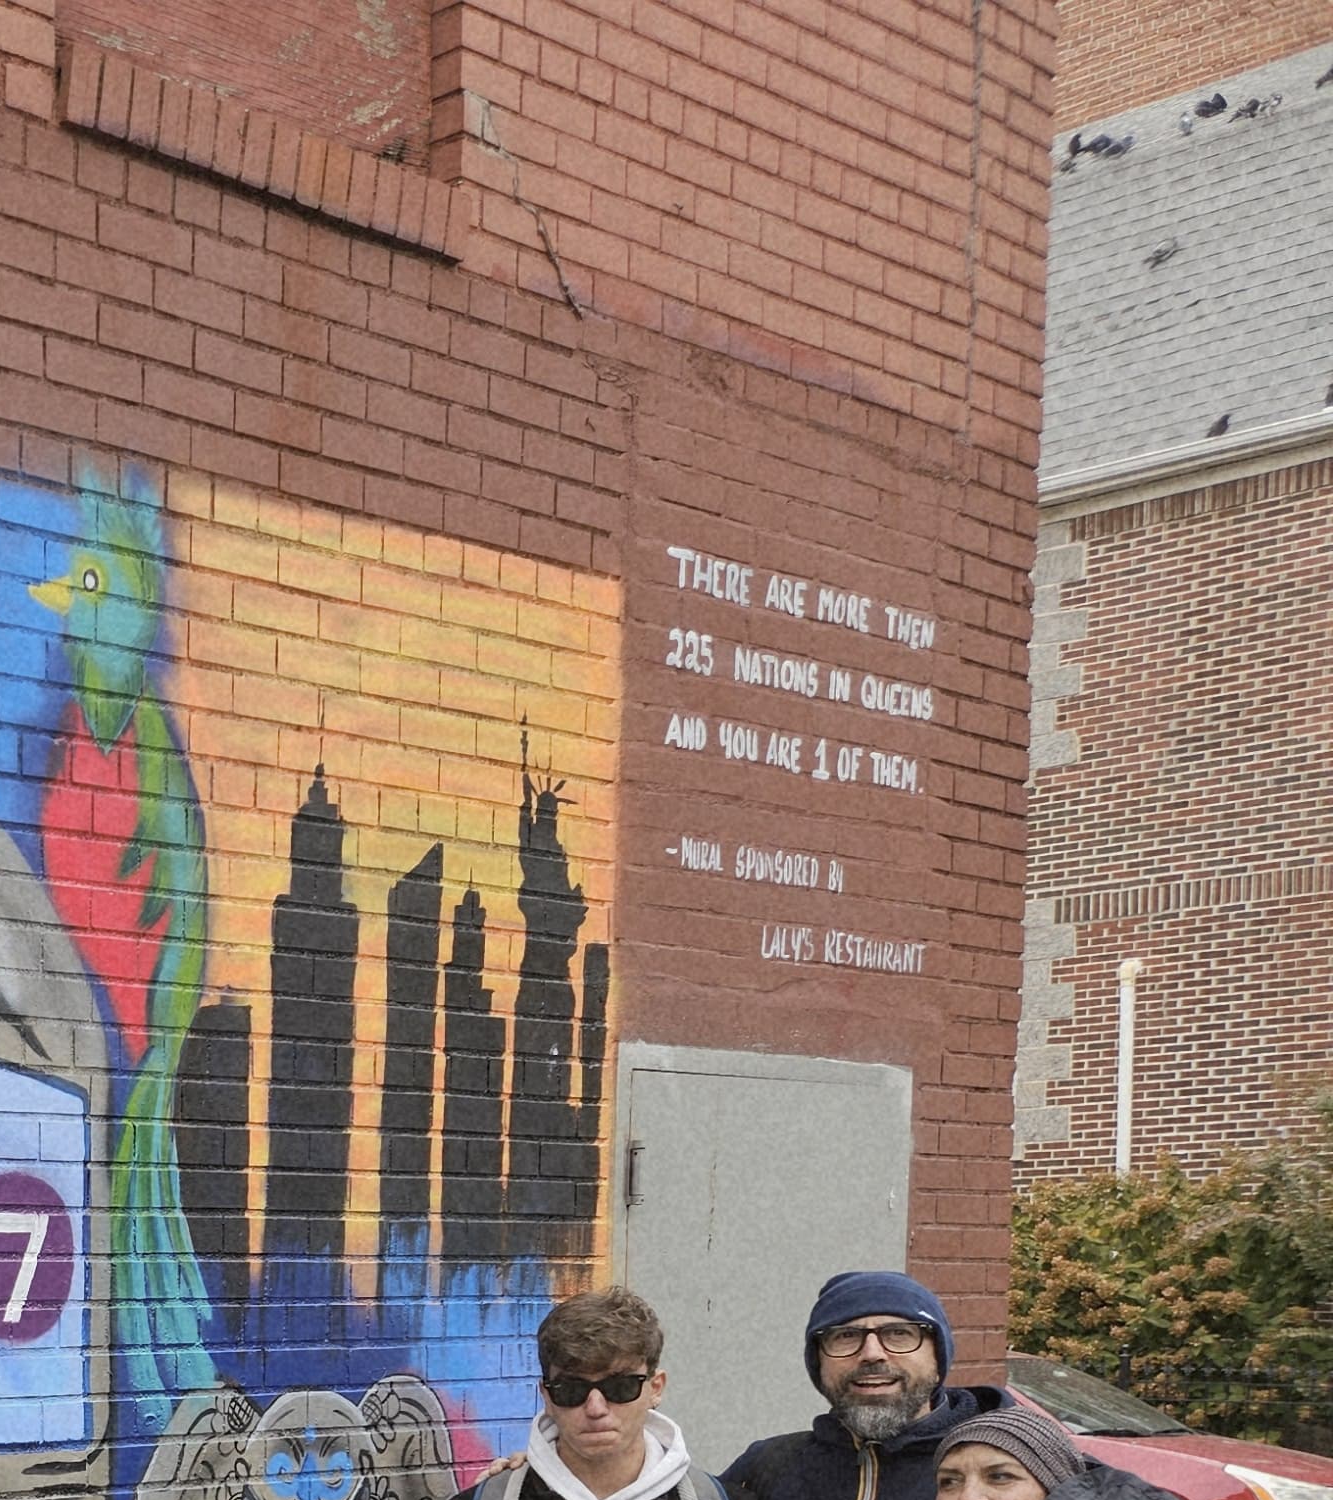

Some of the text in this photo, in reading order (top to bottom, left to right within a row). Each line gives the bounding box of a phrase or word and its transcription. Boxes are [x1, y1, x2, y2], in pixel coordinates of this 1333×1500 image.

[667, 546, 935, 650] THERE ARE MORE THEN
[665, 627, 934, 720] 225 NATIONS IN QUEENS
[664, 713, 925, 795] AND YOU ARE 1 OF THEM.
[735, 846, 819, 889] SPONSORED
[828, 859, 844, 895] BY
[760, 924, 928, 974] LALY'S RESTAURANT
